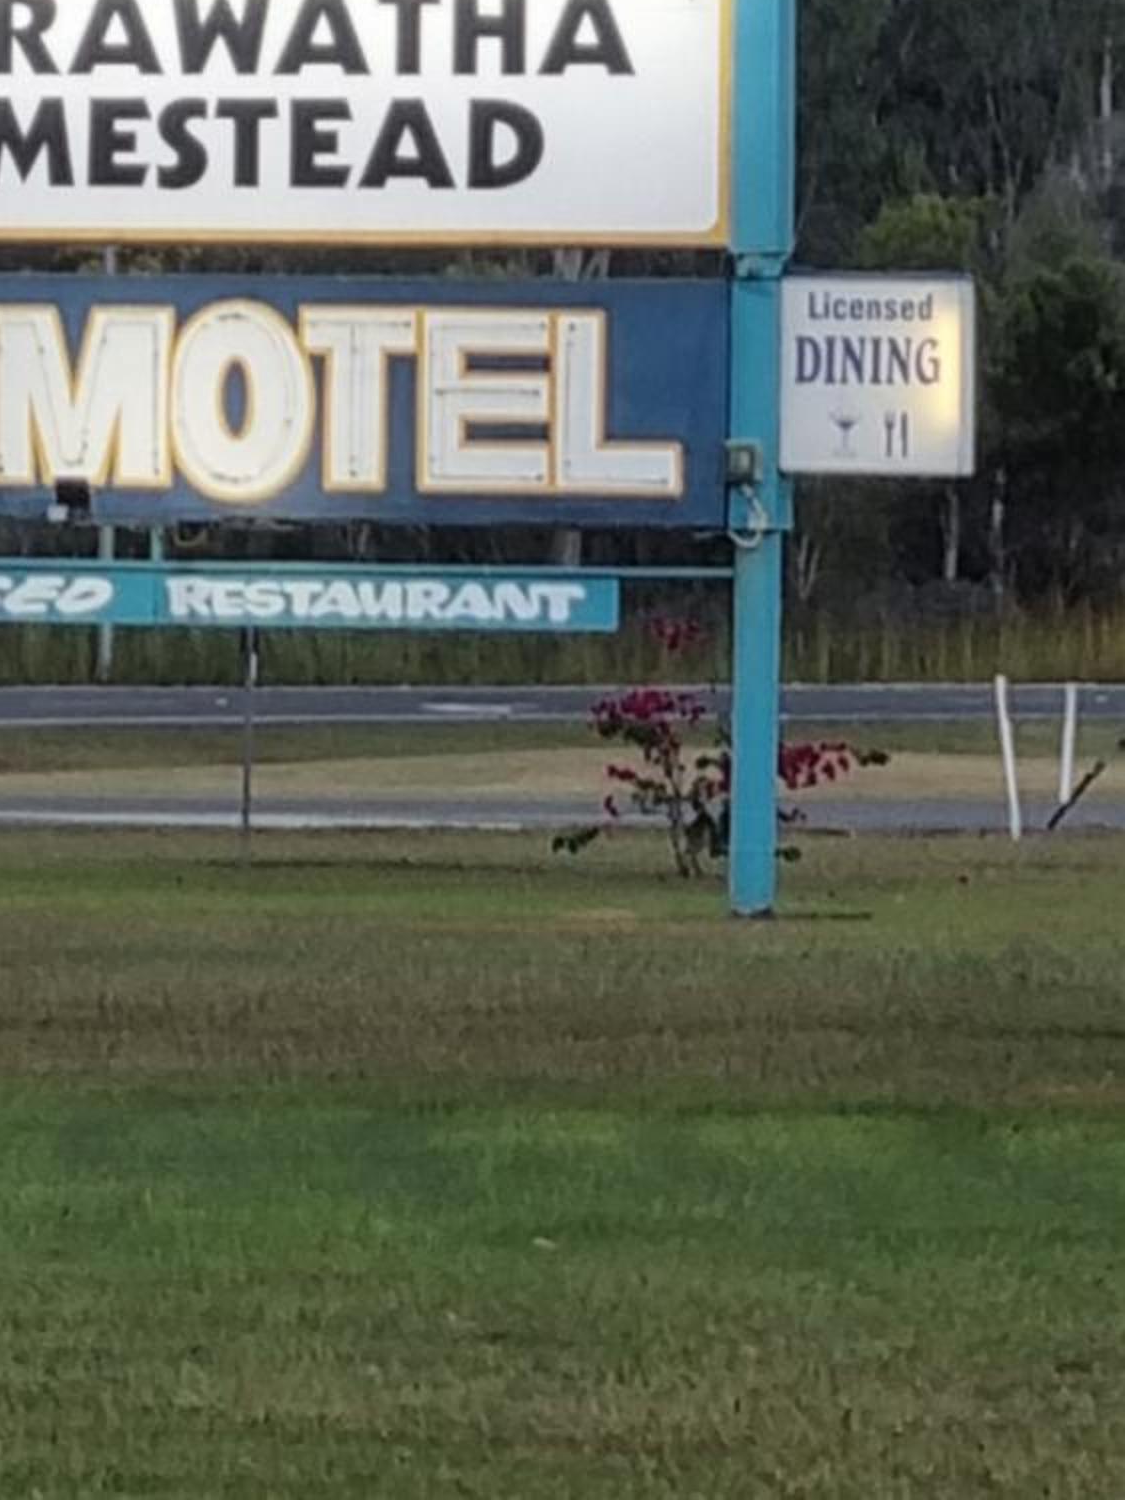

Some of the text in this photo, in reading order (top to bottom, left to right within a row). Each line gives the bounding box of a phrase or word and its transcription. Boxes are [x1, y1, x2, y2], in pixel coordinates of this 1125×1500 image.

[808, 291, 934, 321] Licensed
[794, 335, 942, 385] DINING
[163, 575, 586, 623] RESTAURANT
